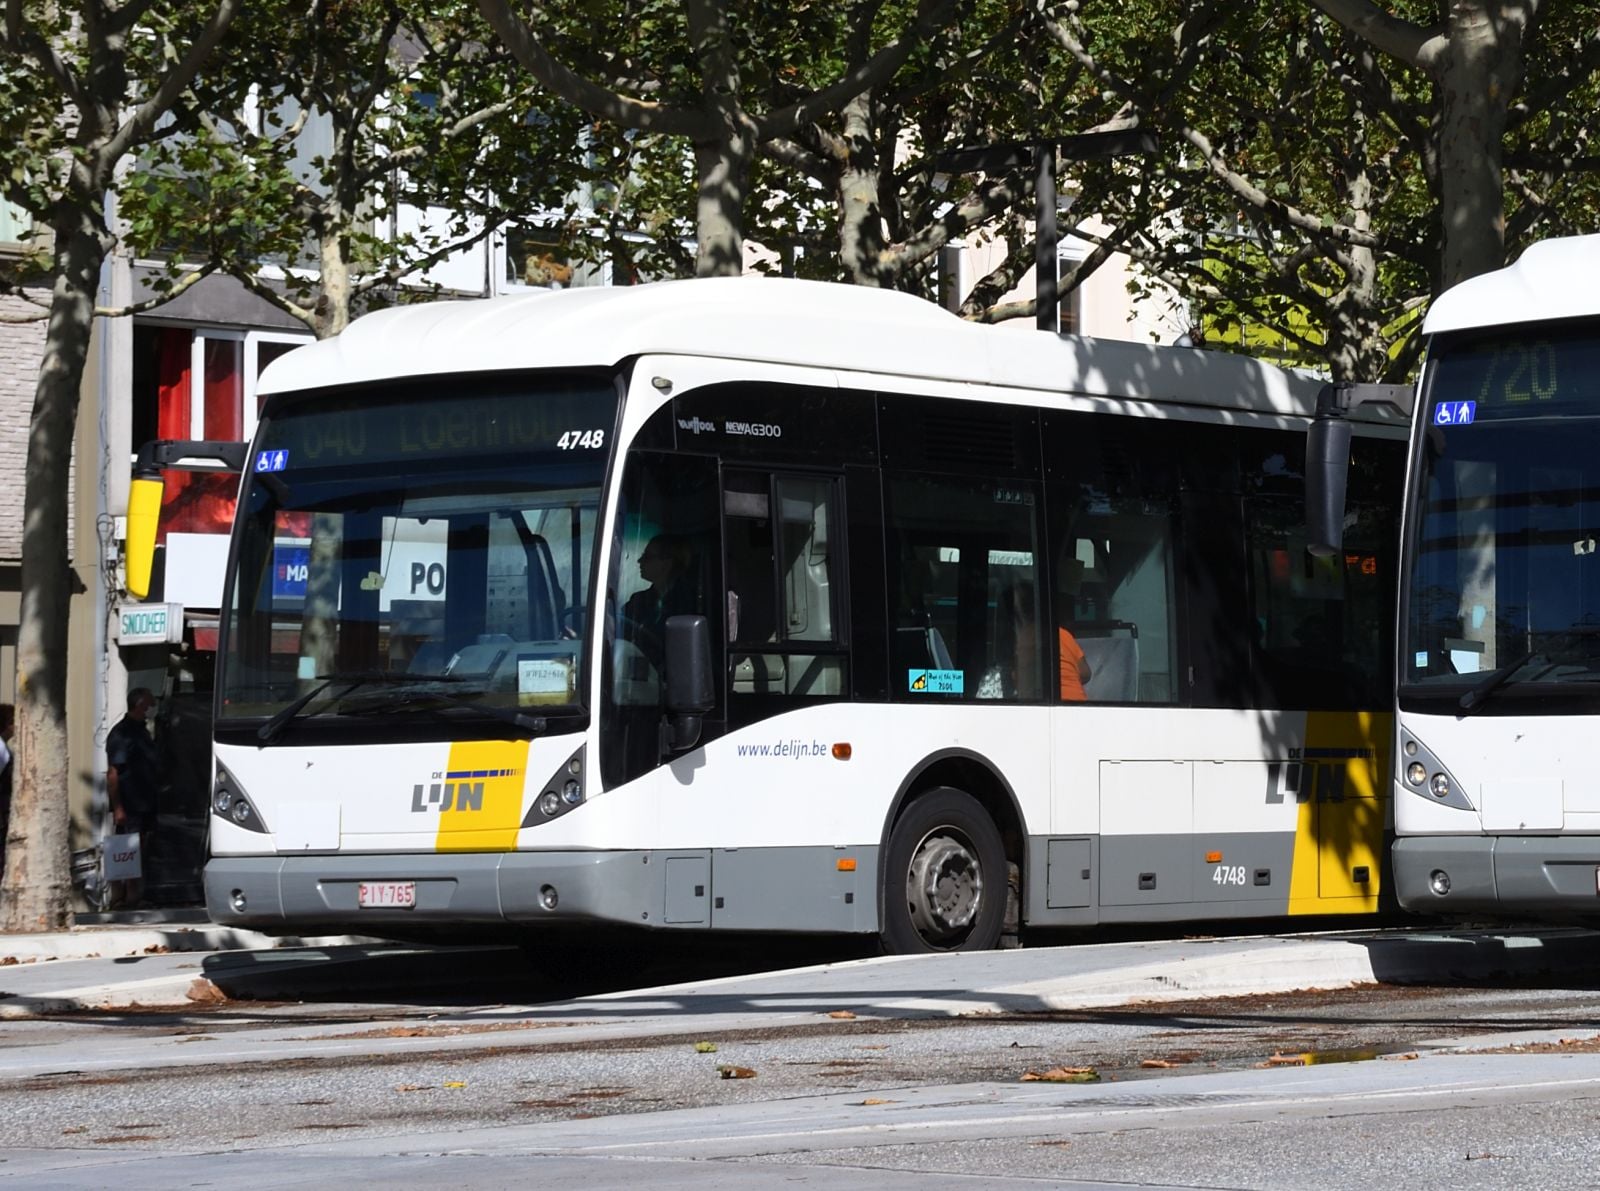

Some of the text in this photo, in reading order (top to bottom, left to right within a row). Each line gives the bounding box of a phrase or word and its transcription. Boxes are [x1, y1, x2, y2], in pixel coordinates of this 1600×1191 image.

[556, 429, 605, 452] 4748
[410, 561, 446, 596] PO
[121, 611, 167, 636] SNOOKER
[737, 739, 828, 760] www.delijn.be
[432, 771, 443, 780] DE
[1265, 762, 1347, 804] LIJN
[411, 782, 485, 813] LIJN
[1212, 865, 1247, 886] 4748
